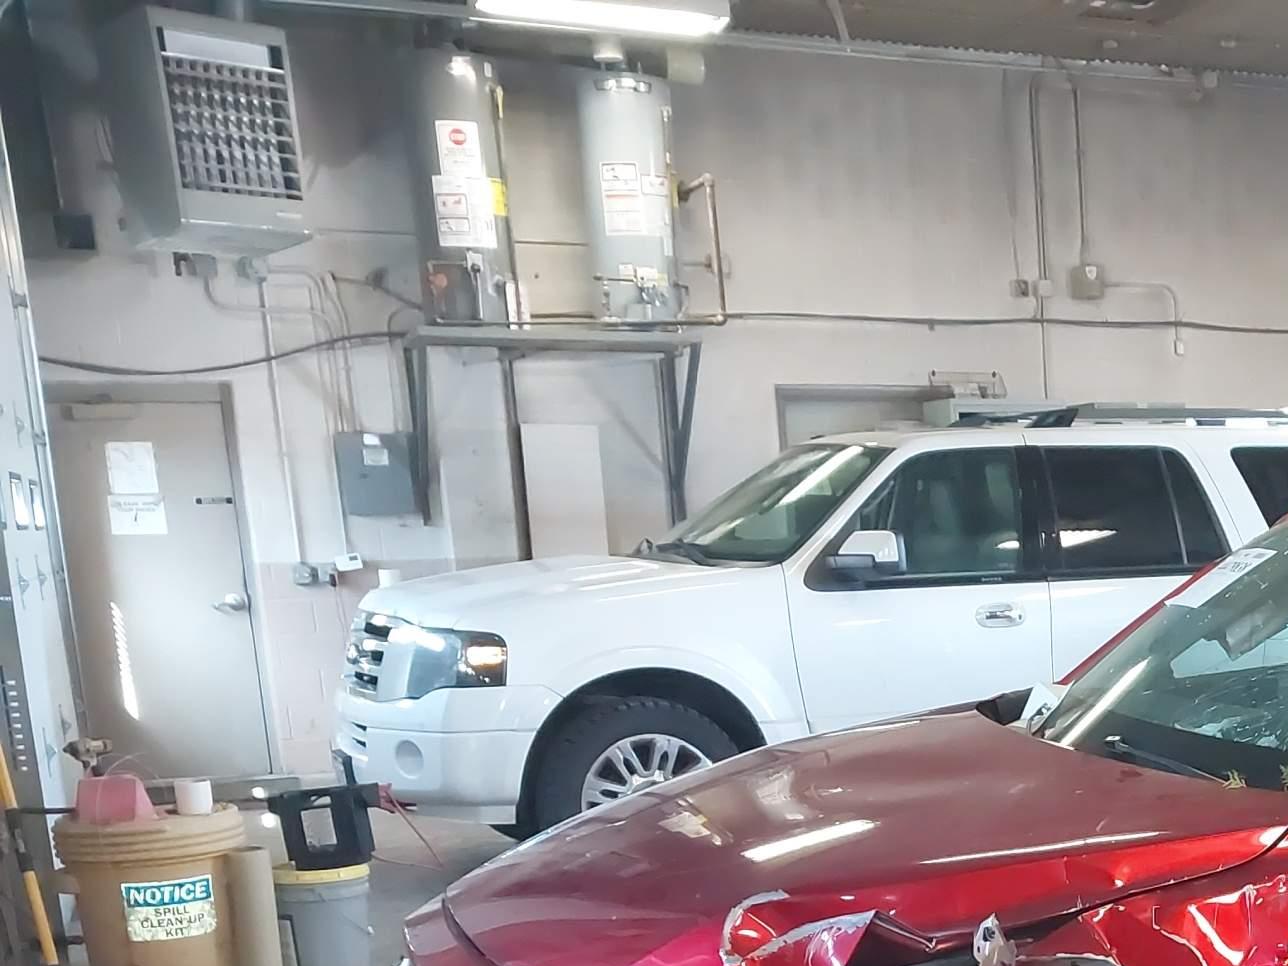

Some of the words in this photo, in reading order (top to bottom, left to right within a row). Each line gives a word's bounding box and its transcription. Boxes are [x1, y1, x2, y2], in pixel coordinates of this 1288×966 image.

[128, 880, 208, 905] NOTICE
[153, 905, 190, 918] SPILL
[165, 926, 186, 938] KIT
